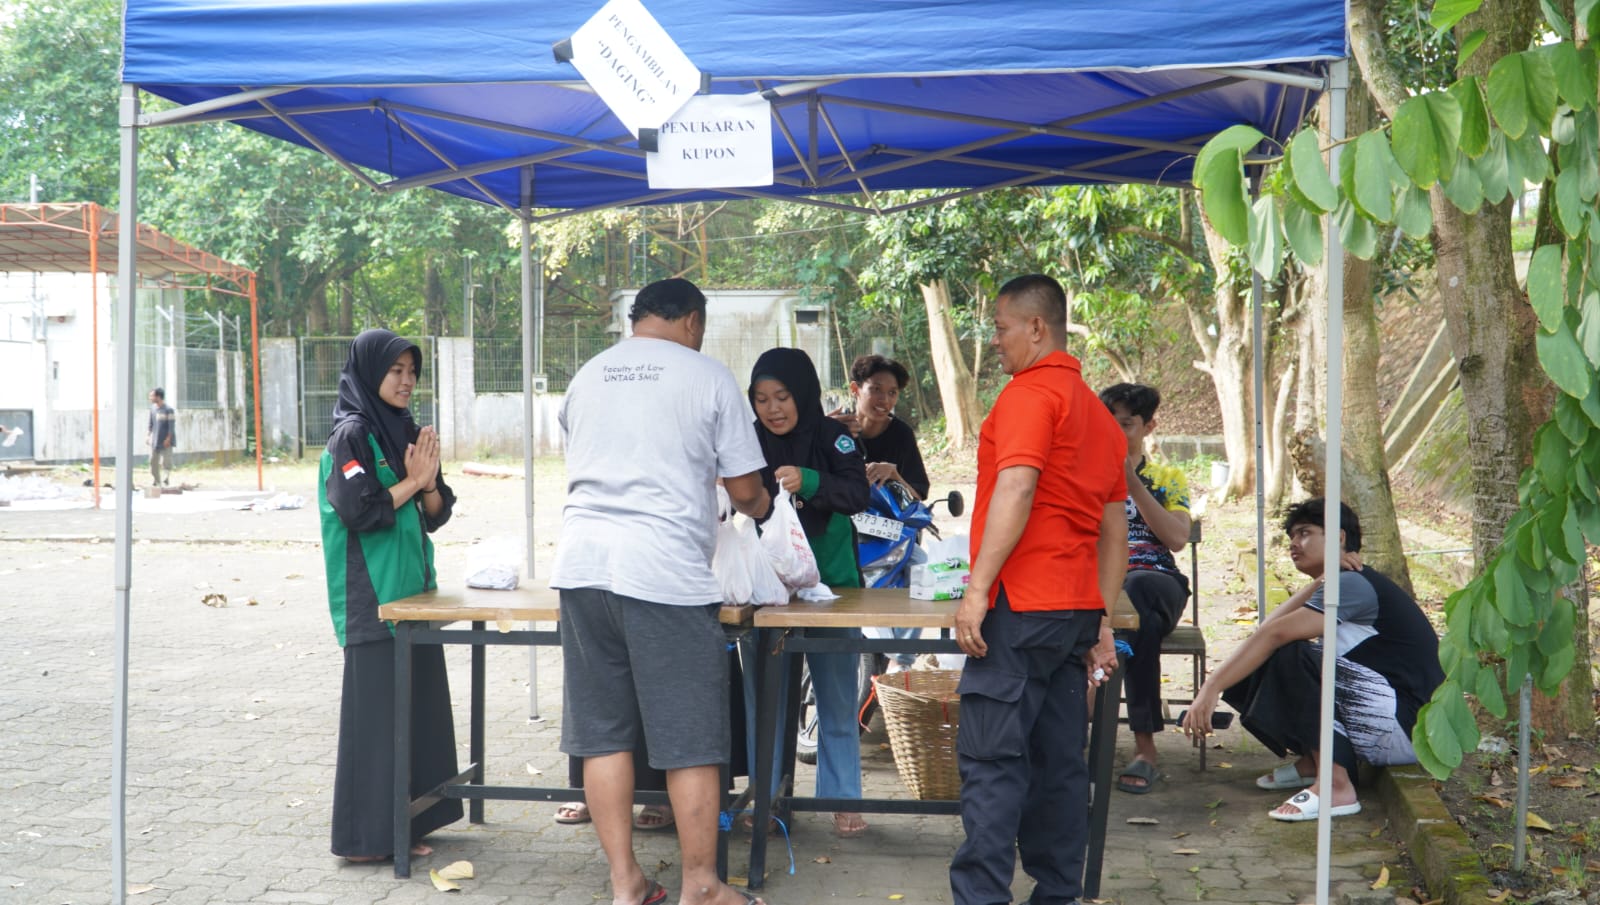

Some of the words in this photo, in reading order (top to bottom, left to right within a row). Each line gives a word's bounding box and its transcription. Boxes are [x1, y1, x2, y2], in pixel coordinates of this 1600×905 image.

[607, 13, 681, 96] PENGAMBILAN
[661, 119, 756, 134] PENUKARAN
[682, 147, 736, 160] KUPON
[603, 365, 632, 373] Faculty
[647, 363, 665, 371] Law
[604, 373, 635, 382] UNTAG
[638, 373, 660, 381] SMG
